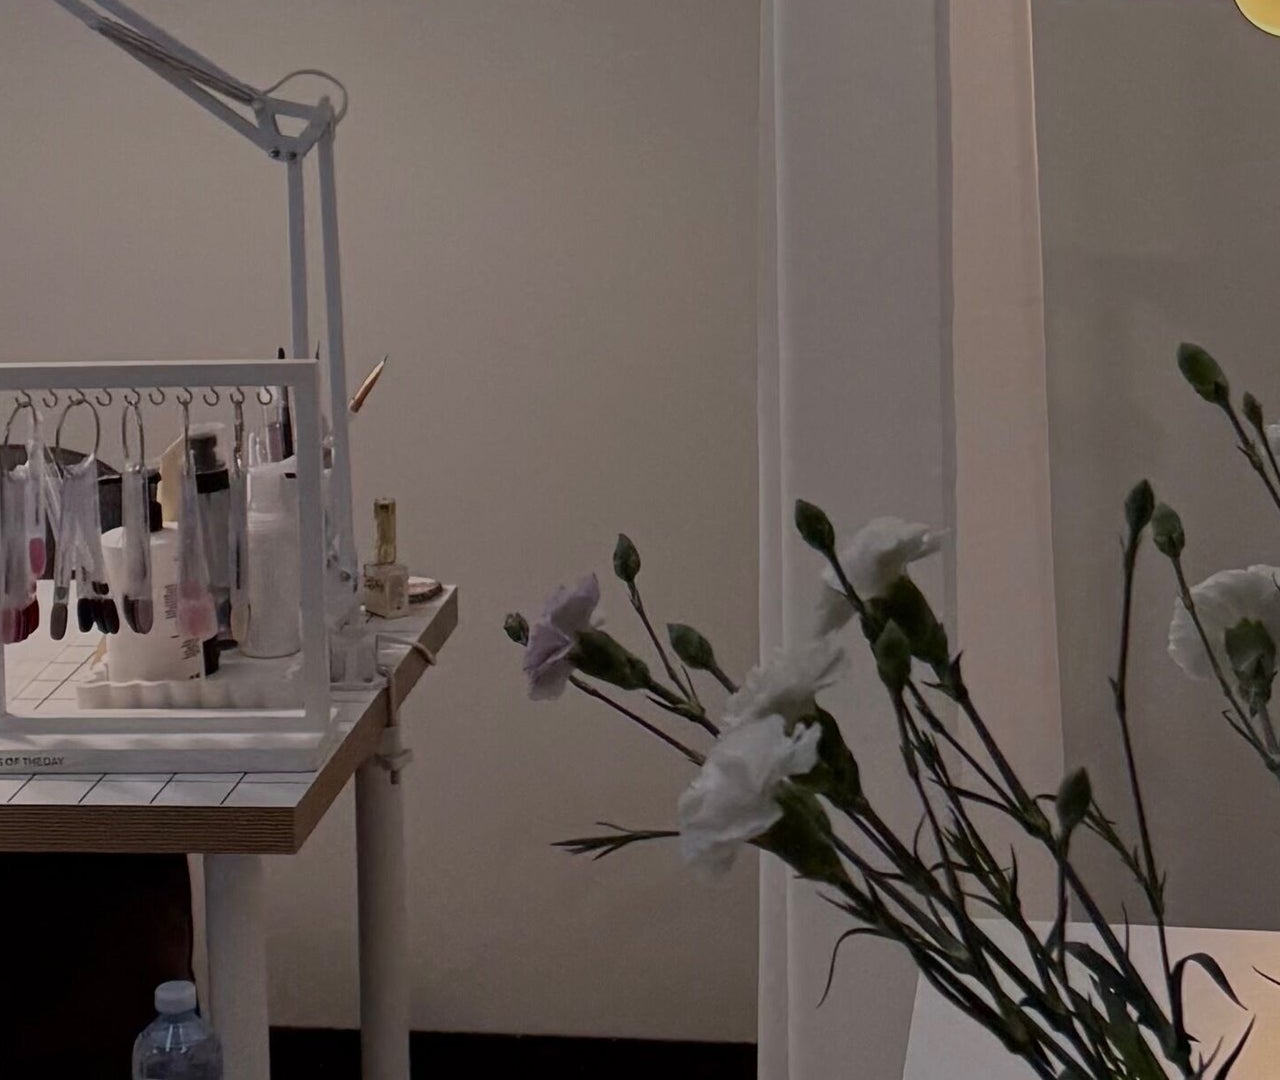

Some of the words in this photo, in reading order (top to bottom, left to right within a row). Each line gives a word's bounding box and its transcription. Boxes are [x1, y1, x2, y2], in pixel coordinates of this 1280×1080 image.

[5, 757, 21, 767] OF
[23, 757, 43, 767] THE
[44, 757, 65, 767] DAY
